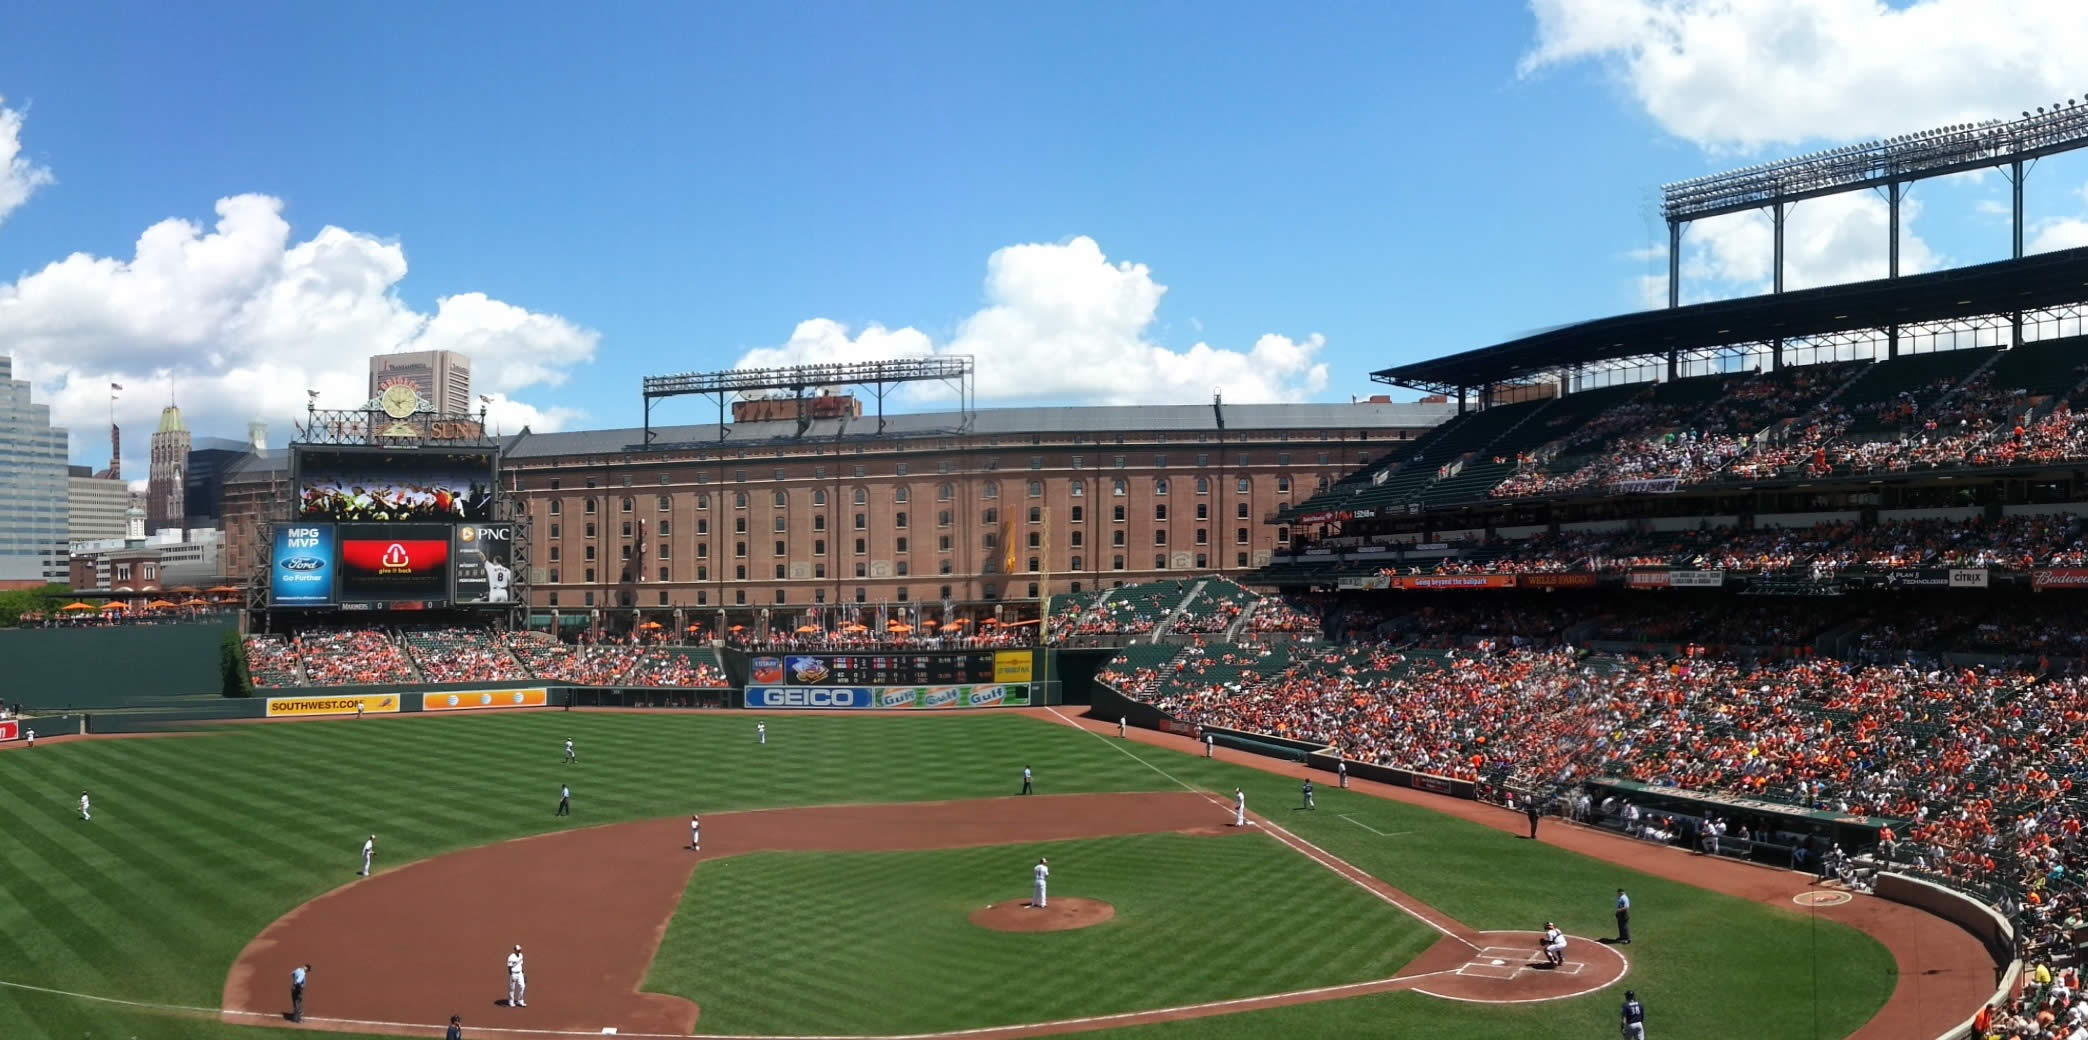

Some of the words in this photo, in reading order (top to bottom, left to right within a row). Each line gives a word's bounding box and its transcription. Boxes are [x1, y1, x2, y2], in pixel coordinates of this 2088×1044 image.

[431, 422, 469, 438] SUN
[287, 528, 319, 538] MPG
[478, 528, 510, 540] PNC
[287, 538, 319, 548] MVP
[288, 557, 318, 569] Ford
[497, 572, 504, 582] 8
[1528, 575, 1557, 585] WELLS
[1559, 575, 1588, 585] FARGO
[763, 688, 854, 706] GEICO
[884, 690, 915, 705] Gulf
[925, 688, 957, 705] Gulf
[970, 687, 1003, 704] Gulf
[1631, 1005, 1641, 1016] 38
